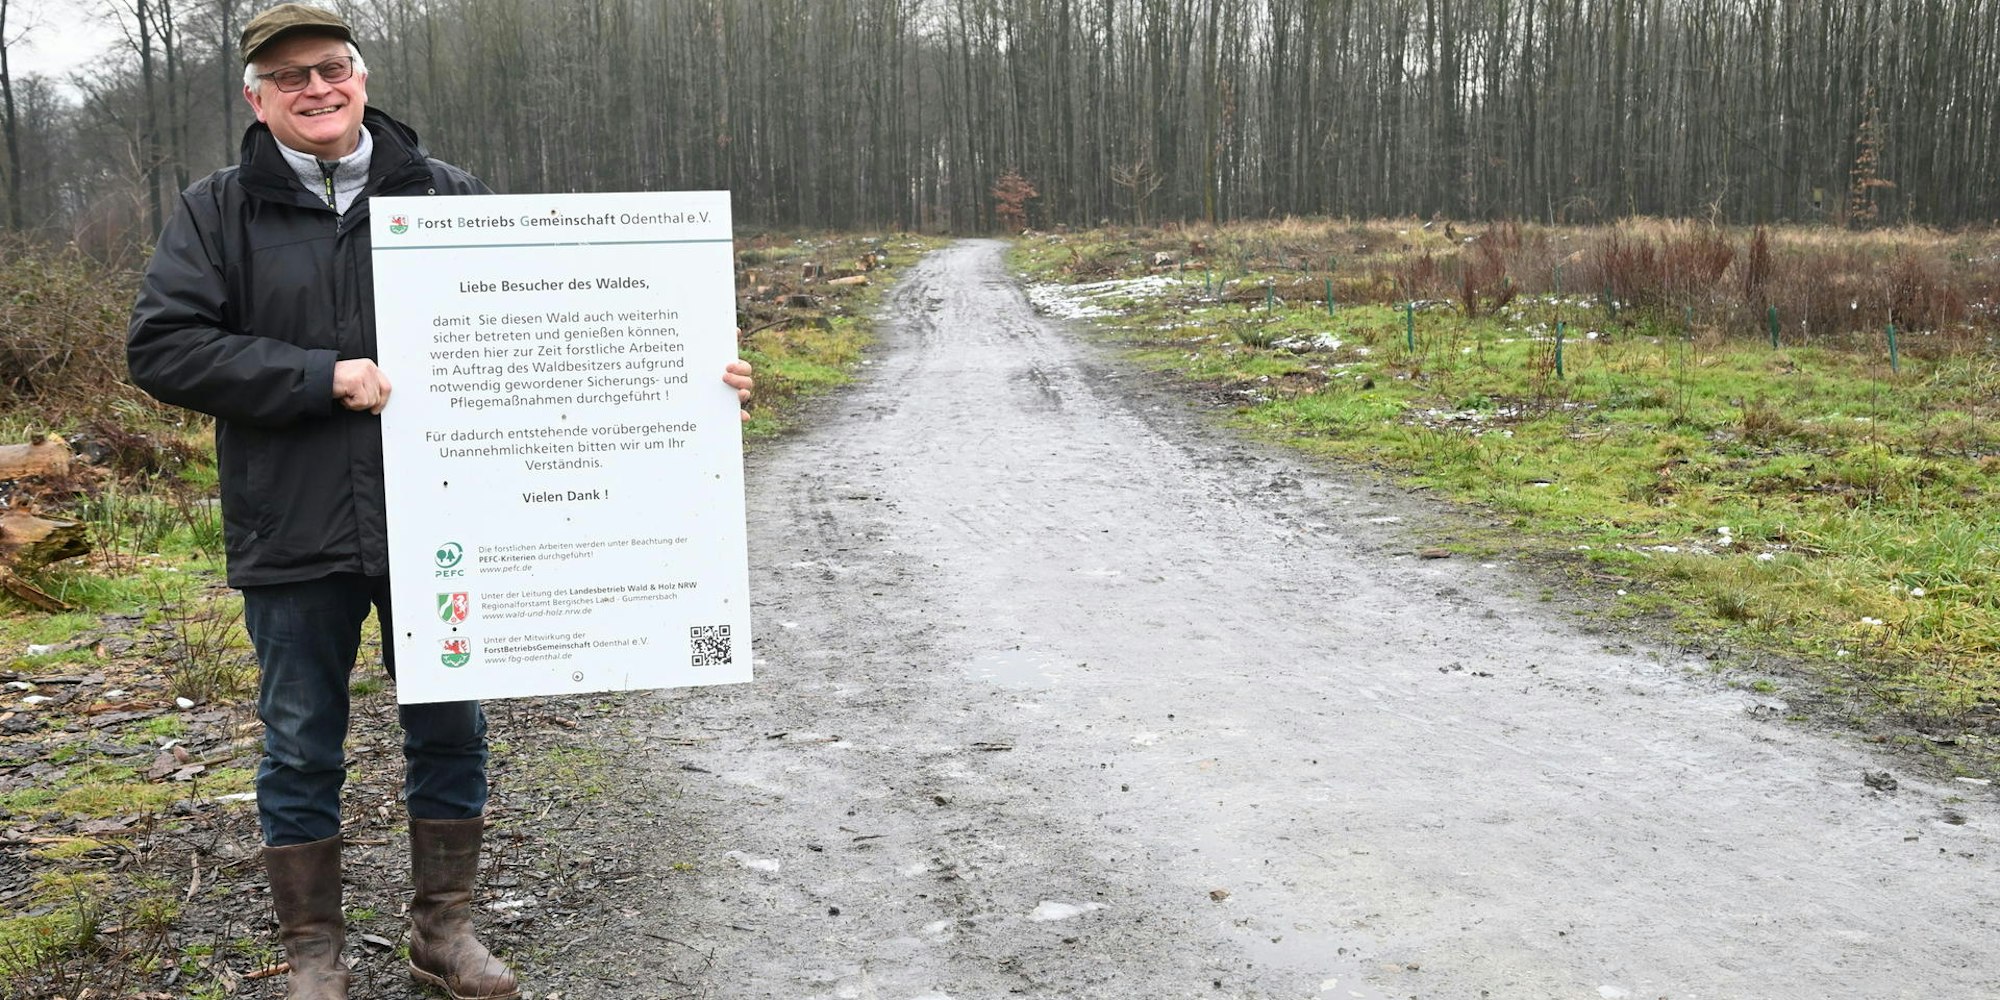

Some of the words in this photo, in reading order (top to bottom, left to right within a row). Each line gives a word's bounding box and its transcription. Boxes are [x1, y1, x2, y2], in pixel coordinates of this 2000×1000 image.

[417, 217, 453, 229] Forst
[457, 215, 515, 228] Betriebs
[519, 213, 616, 227] Gemeinschaft
[620, 211, 684, 225] Odenthal
[686, 211, 711, 224] e.V.
[459, 280, 497, 293] Liebe
[501, 278, 564, 292] Besucher
[567, 277, 592, 290] des
[595, 276, 650, 290] Waldes,
[432, 314, 471, 327] damit
[478, 313, 497, 326] Sie
[500, 313, 543, 325] diesen
[545, 311, 580, 324] Wald
[583, 310, 614, 323] auch
[617, 308, 679, 321] weiterhin
[433, 331, 471, 344] sicher
[474, 330, 531, 342] betreten
[534, 327, 560, 340] und
[563, 326, 624, 342] genießen
[627, 325, 679, 337] können,
[429, 347, 480, 360] werden
[483, 346, 509, 358] hier
[512, 348, 534, 357] zur
[537, 344, 562, 356] Zeit
[565, 342, 625, 355] forstliche
[628, 341, 684, 353] Arbeiten
[432, 364, 448, 376] im
[452, 362, 503, 376] Auftrag
[506, 362, 529, 374] des
[531, 359, 622, 373] Waldbesitzers
[624, 356, 684, 372] aufgrund
[429, 379, 501, 394] notwendig
[504, 377, 583, 394] gewordener
[586, 375, 660, 388] Sicherungs-
[663, 372, 688, 384] und
[450, 393, 573, 411] Pflegemaßnahmen
[576, 389, 661, 406] durchgeführt
[665, 389, 669, 401] !
[425, 430, 447, 442] Für
[450, 428, 504, 442] dadurch
[507, 425, 588, 439] entstehende
[591, 420, 697, 437] vorübergehende
[439, 442, 574, 458] Unannehmlichkeiten
[577, 440, 616, 453] bitten
[619, 439, 640, 451] wir
[644, 440, 664, 450] um
[668, 437, 685, 448] Ihr
[524, 457, 603, 471] Verständnis.
[521, 491, 563, 503] Vielen
[567, 488, 600, 501] Dank
[604, 488, 608, 500] !
[478, 545, 492, 554] Die
[493, 543, 537, 553] forstlichen
[538, 542, 574, 550] Arbeiten
[574, 540, 606, 549] werden
[607, 539, 629, 547] unter
[630, 537, 673, 546] Beachtung
[674, 536, 688, 544] der
[478, 553, 536, 563] PEFC-Kriterien
[537, 550, 594, 561] durchgeführt!
[434, 568, 464, 578] PEFC
[479, 563, 533, 574] www.pefc.de
[505, 591, 519, 599] der
[521, 590, 552, 598] Leitung
[553, 588, 568, 596] des
[569, 584, 626, 596] Landesbetrieb
[626, 583, 648, 592] Wald
[649, 583, 656, 591] &
[657, 582, 676, 590] Holz
[677, 581, 697, 589] NRW
[481, 599, 550, 611] Regionalforstamt
[552, 597, 594, 607] Bergisches
[621, 592, 678, 603] Gummersbach
[481, 606, 592, 620] www.wald-und-holz.nrw.de
[483, 636, 506, 644] Unter
[508, 635, 522, 643] der
[523, 633, 571, 642] Mitwirkung
[572, 631, 586, 639] der
[484, 640, 591, 654] ForstBetriebsGemeinschaft
[592, 638, 630, 648] Odenthal
[632, 636, 650, 646] e.V.
[484, 651, 573, 664] www.fbg-odenthal.de
